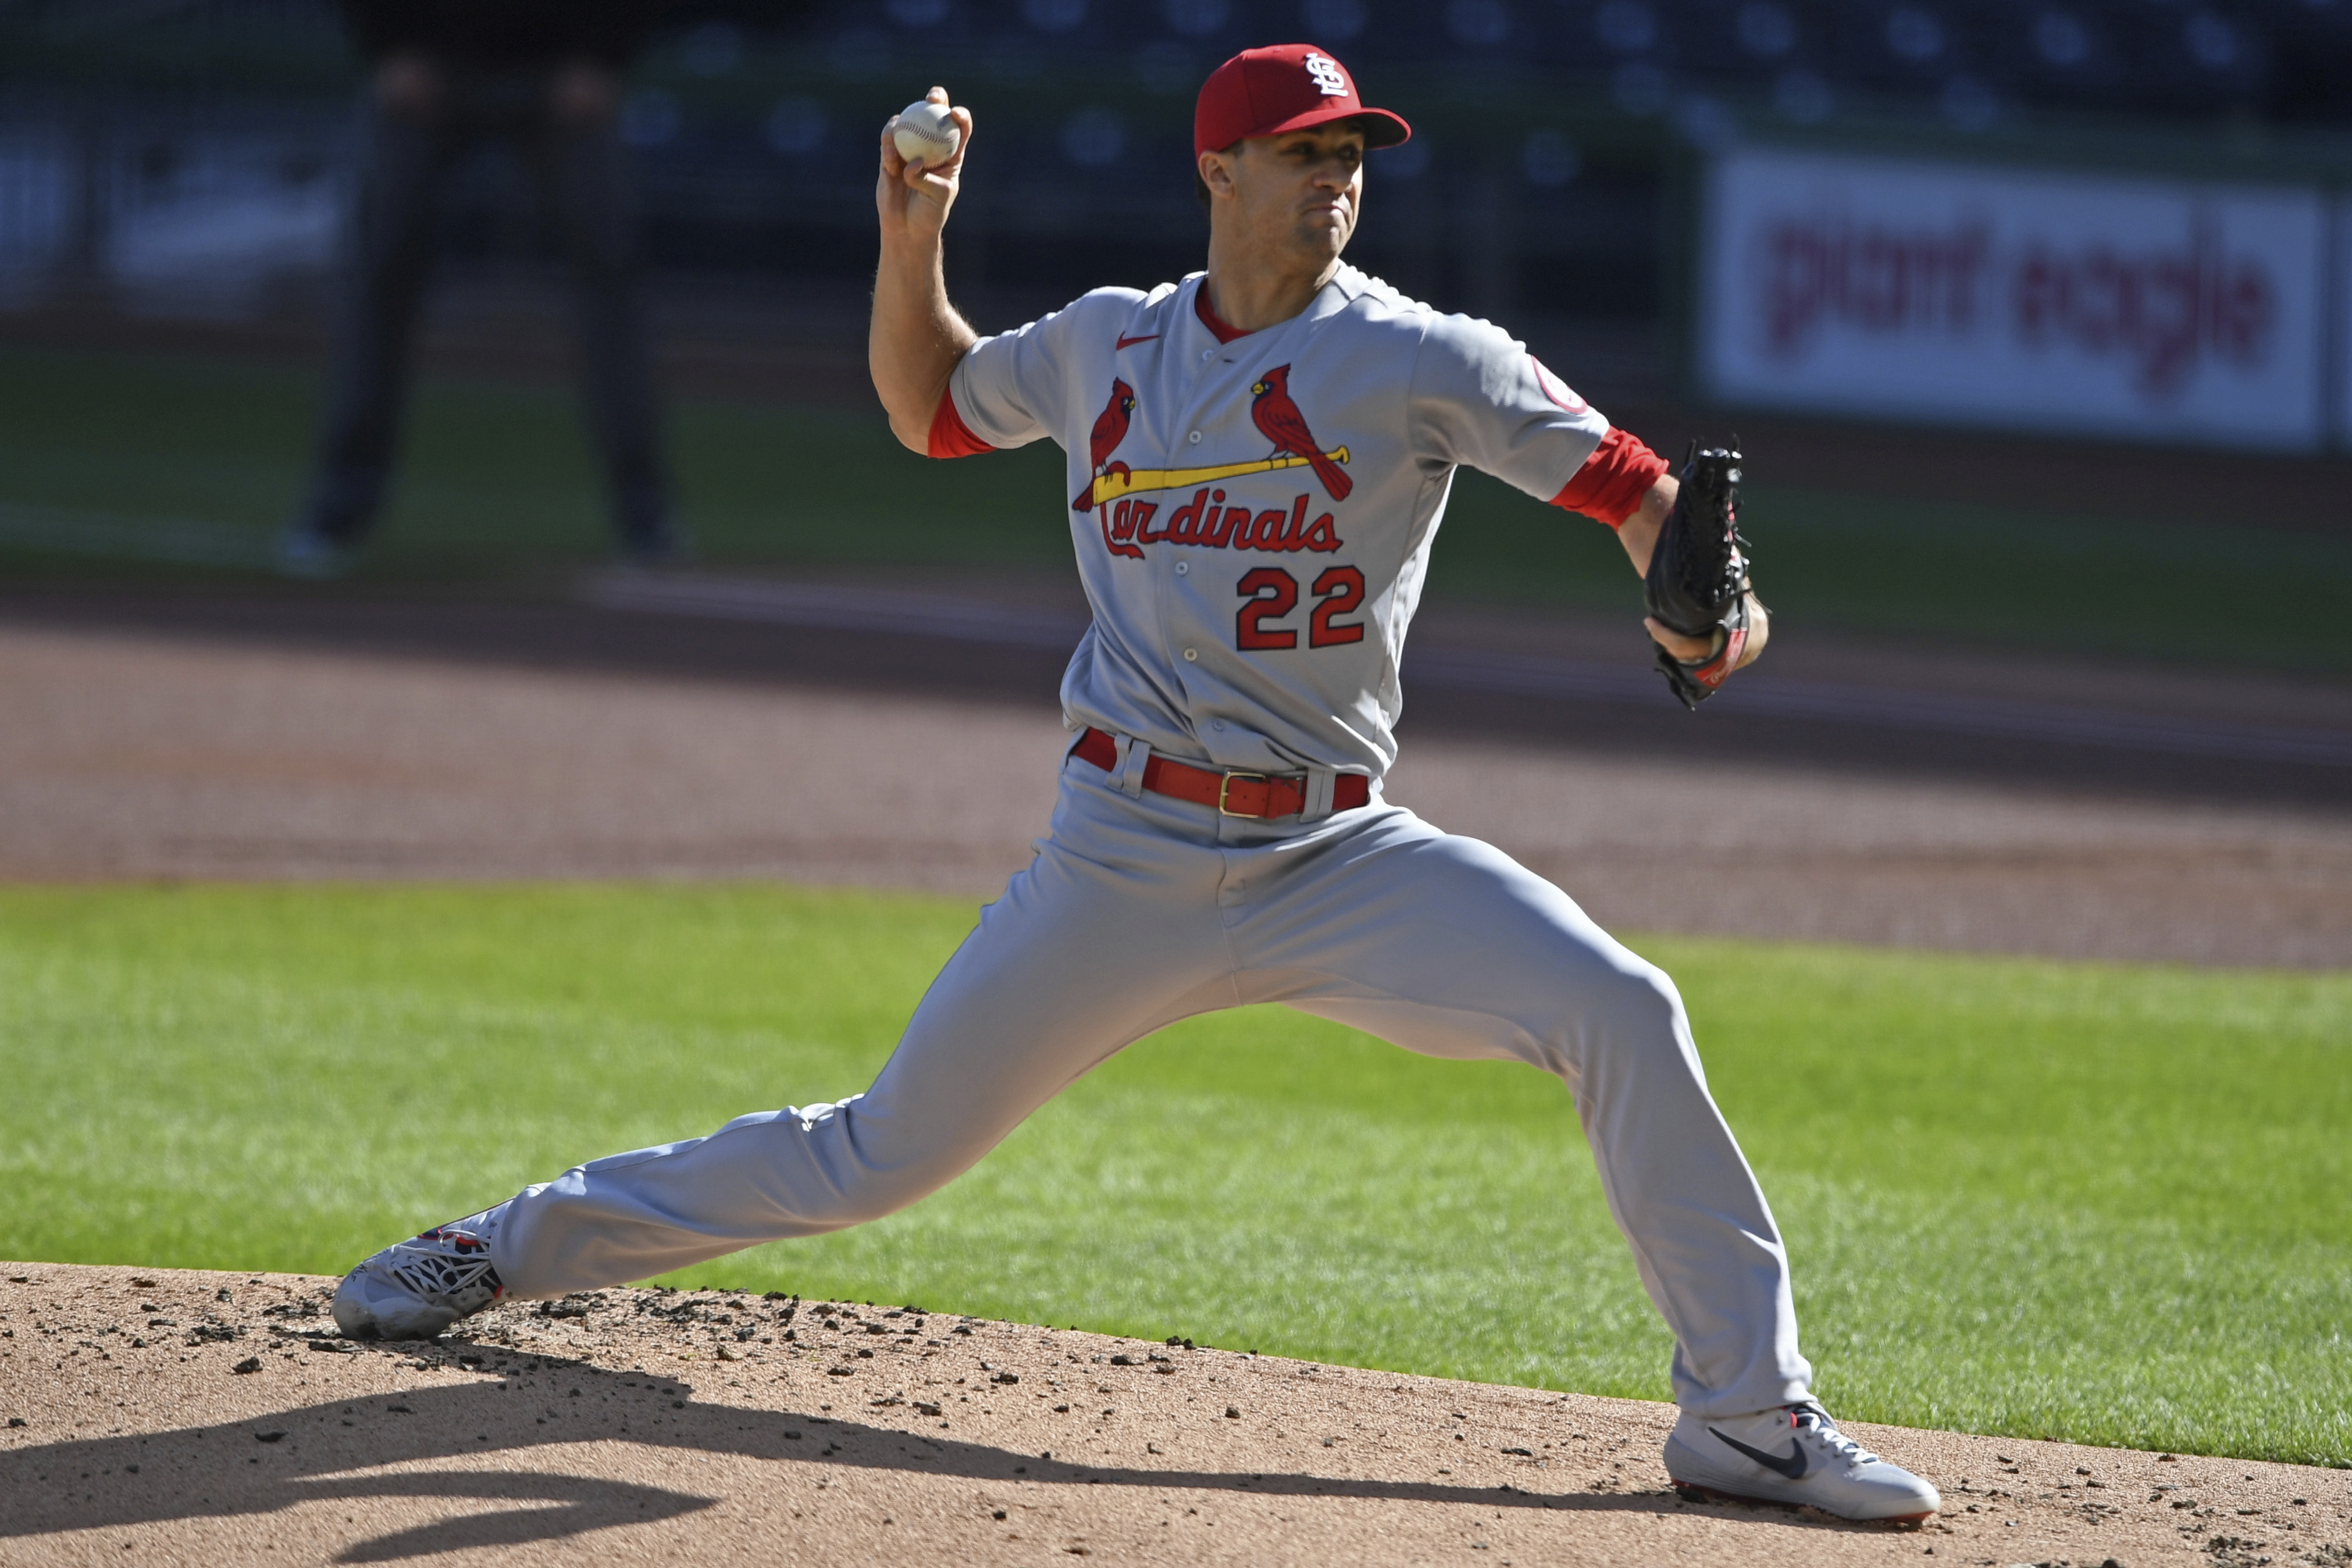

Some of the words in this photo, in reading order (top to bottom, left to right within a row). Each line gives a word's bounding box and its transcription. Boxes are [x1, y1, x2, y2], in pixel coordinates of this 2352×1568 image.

[1767, 212, 1992, 361] giant
[2015, 211, 2274, 401] eagle
[1099, 465, 1344, 560] Cardinals
[1236, 565, 1365, 651] 22
